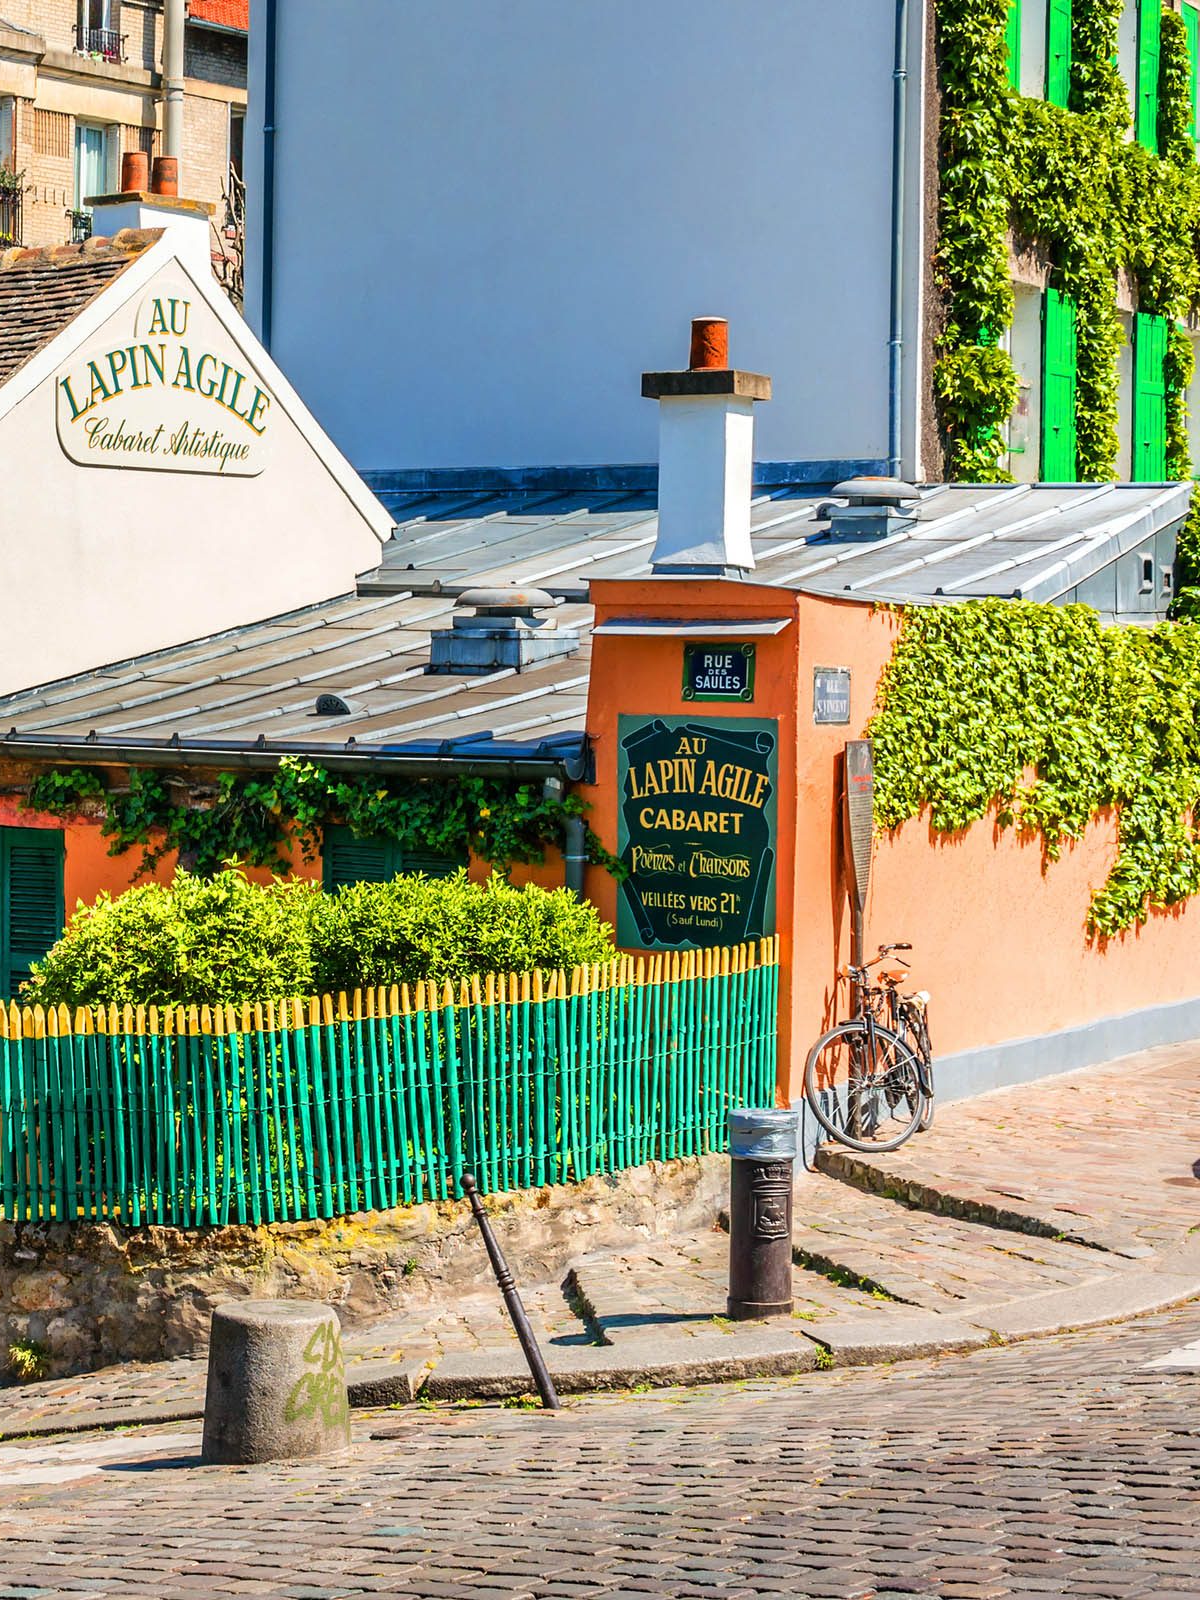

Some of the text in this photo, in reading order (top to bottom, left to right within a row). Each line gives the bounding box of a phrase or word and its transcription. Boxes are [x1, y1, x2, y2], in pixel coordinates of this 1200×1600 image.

[148, 298, 191, 337] AU
[60, 344, 271, 437] LAPIN AGILE
[84, 416, 250, 471] Cabaret Artistique
[704, 655, 733, 668] RUE
[695, 675, 741, 689] SAULES
[675, 736, 707, 755] AU
[628, 758, 769, 809] LAPIN AGILE
[640, 807, 744, 834] CABARET
[631, 845, 751, 878] Poèmes et Chansons
[641, 891, 686, 909] VEILLÉES
[689, 895, 717, 912] VERS
[666, 912, 723, 932] (Sauf Lundi)
